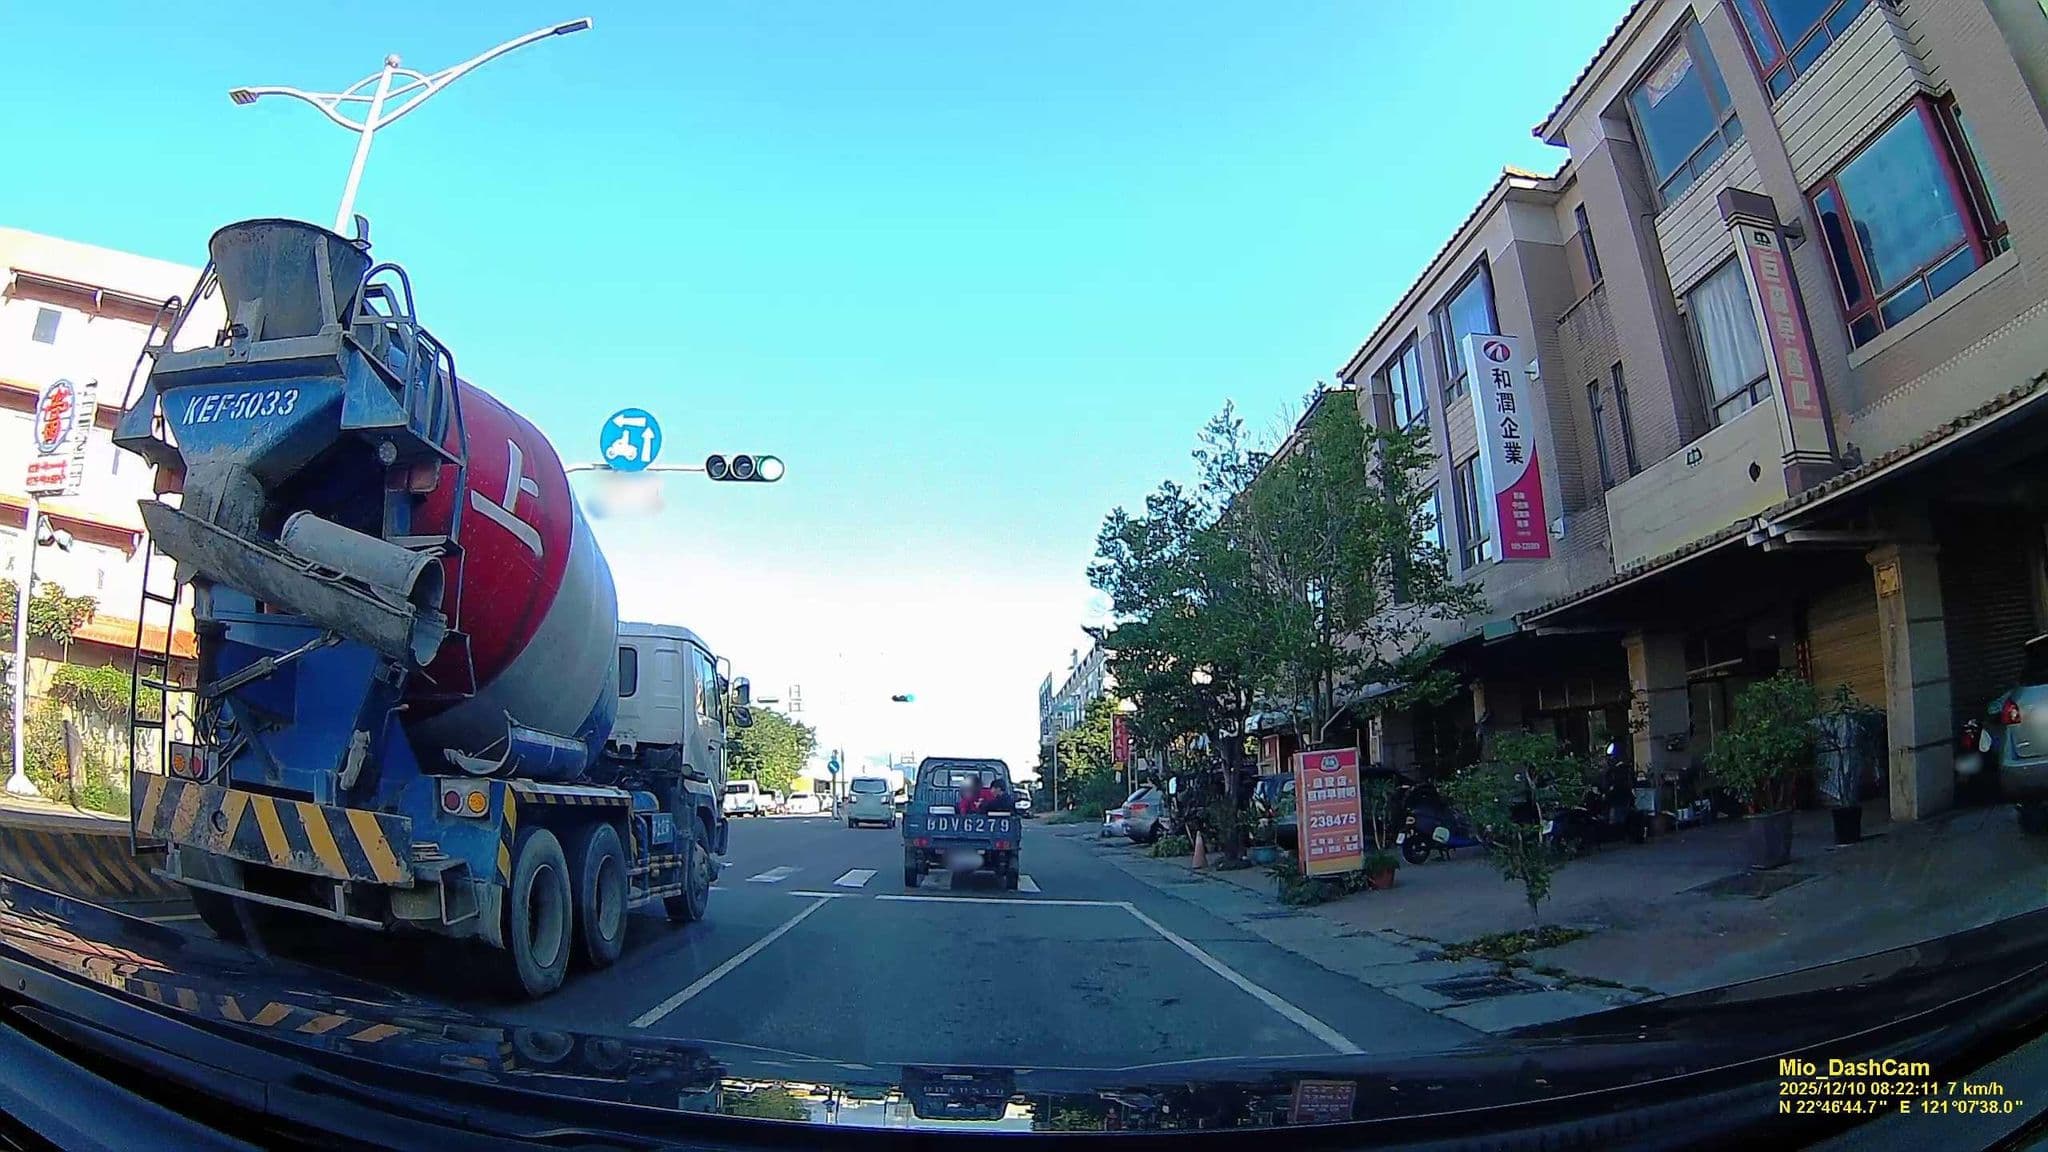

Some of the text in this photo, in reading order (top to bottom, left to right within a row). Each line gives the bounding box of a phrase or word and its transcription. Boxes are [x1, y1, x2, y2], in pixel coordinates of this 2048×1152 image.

[1491, 367, 1524, 465] 和潤企業
[470, 438, 544, 558] 上
[1310, 812, 1357, 828] 238475
